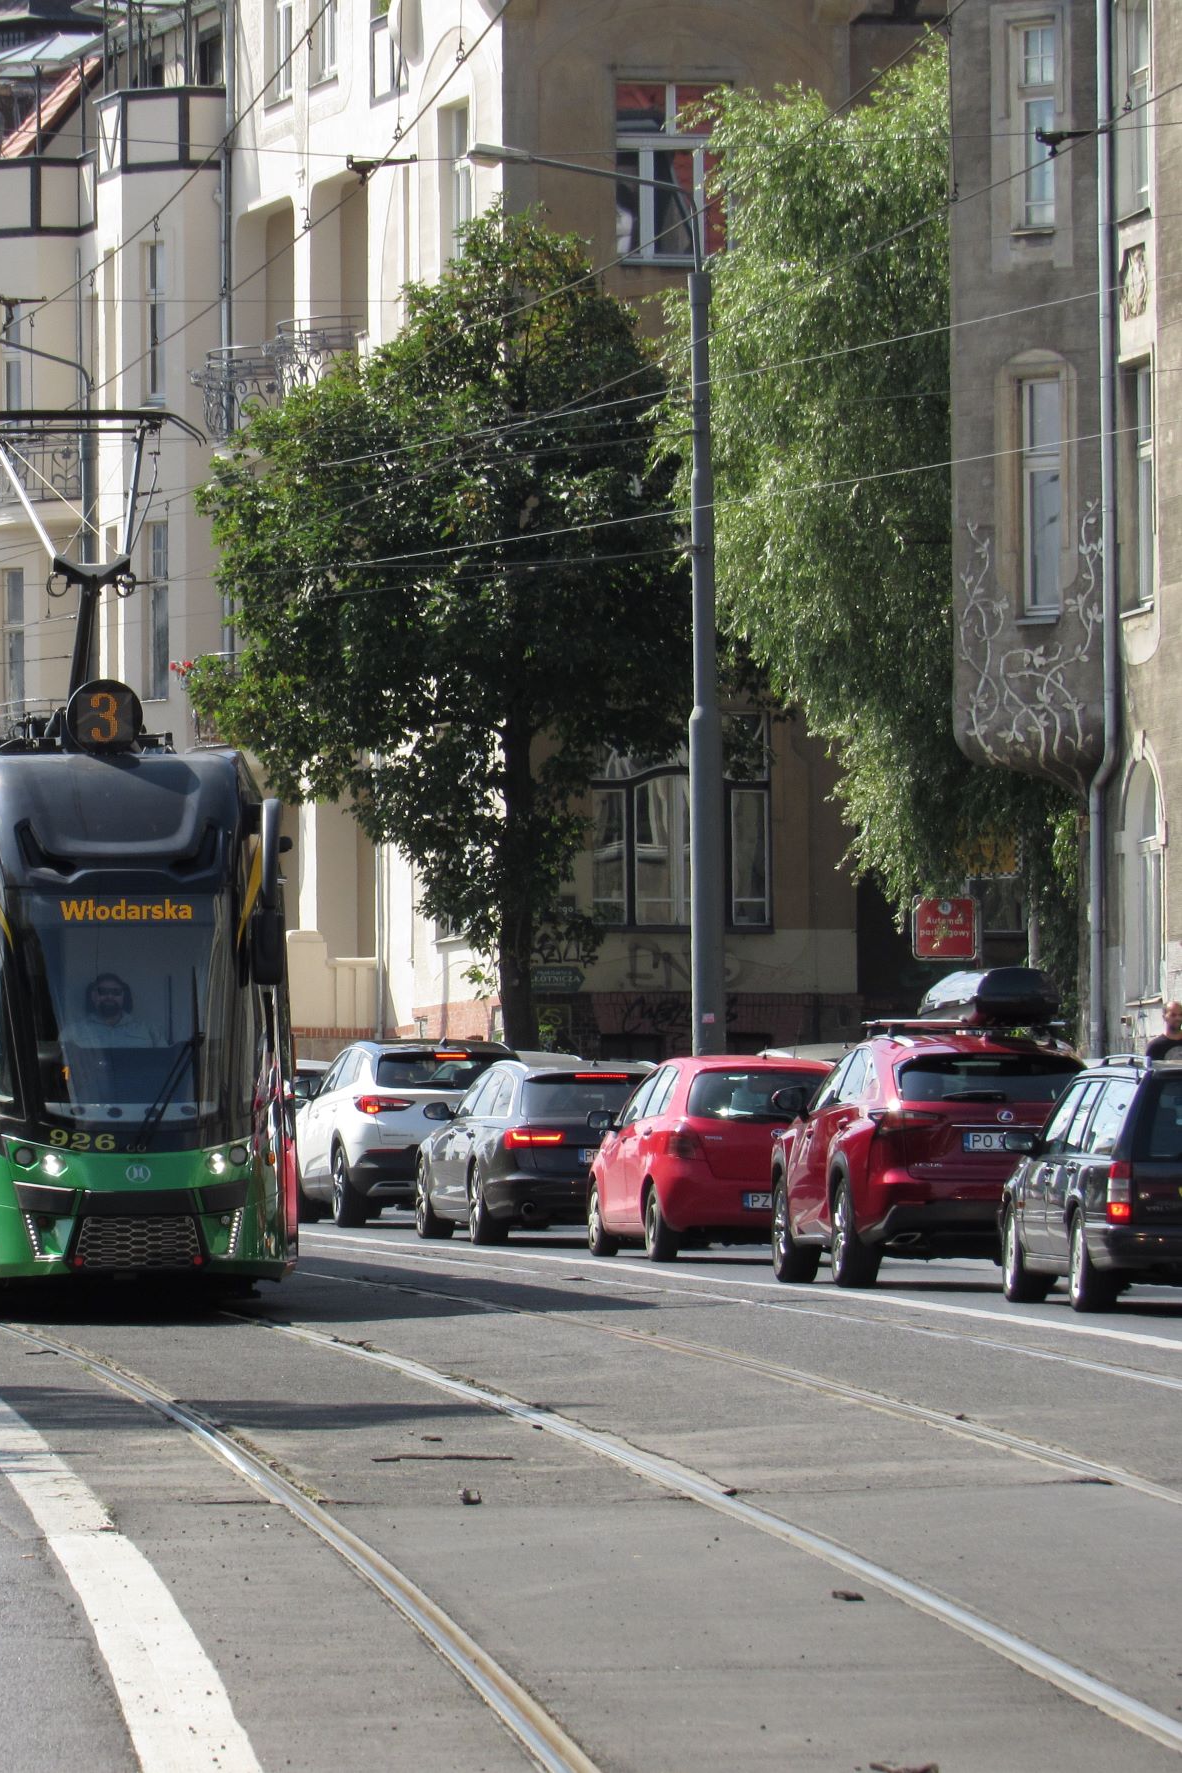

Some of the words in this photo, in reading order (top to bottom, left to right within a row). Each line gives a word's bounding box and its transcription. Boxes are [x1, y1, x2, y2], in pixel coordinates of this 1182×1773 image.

[91, 692, 119, 742] 3
[60, 899, 193, 921] Włodarska
[920, 928, 970, 938] parkgowy
[532, 975, 581, 983] ŁOTNICZA
[49, 1128, 116, 1151] 926
[972, 1135, 993, 1148] PO
[751, 1195, 770, 1208] PZ
